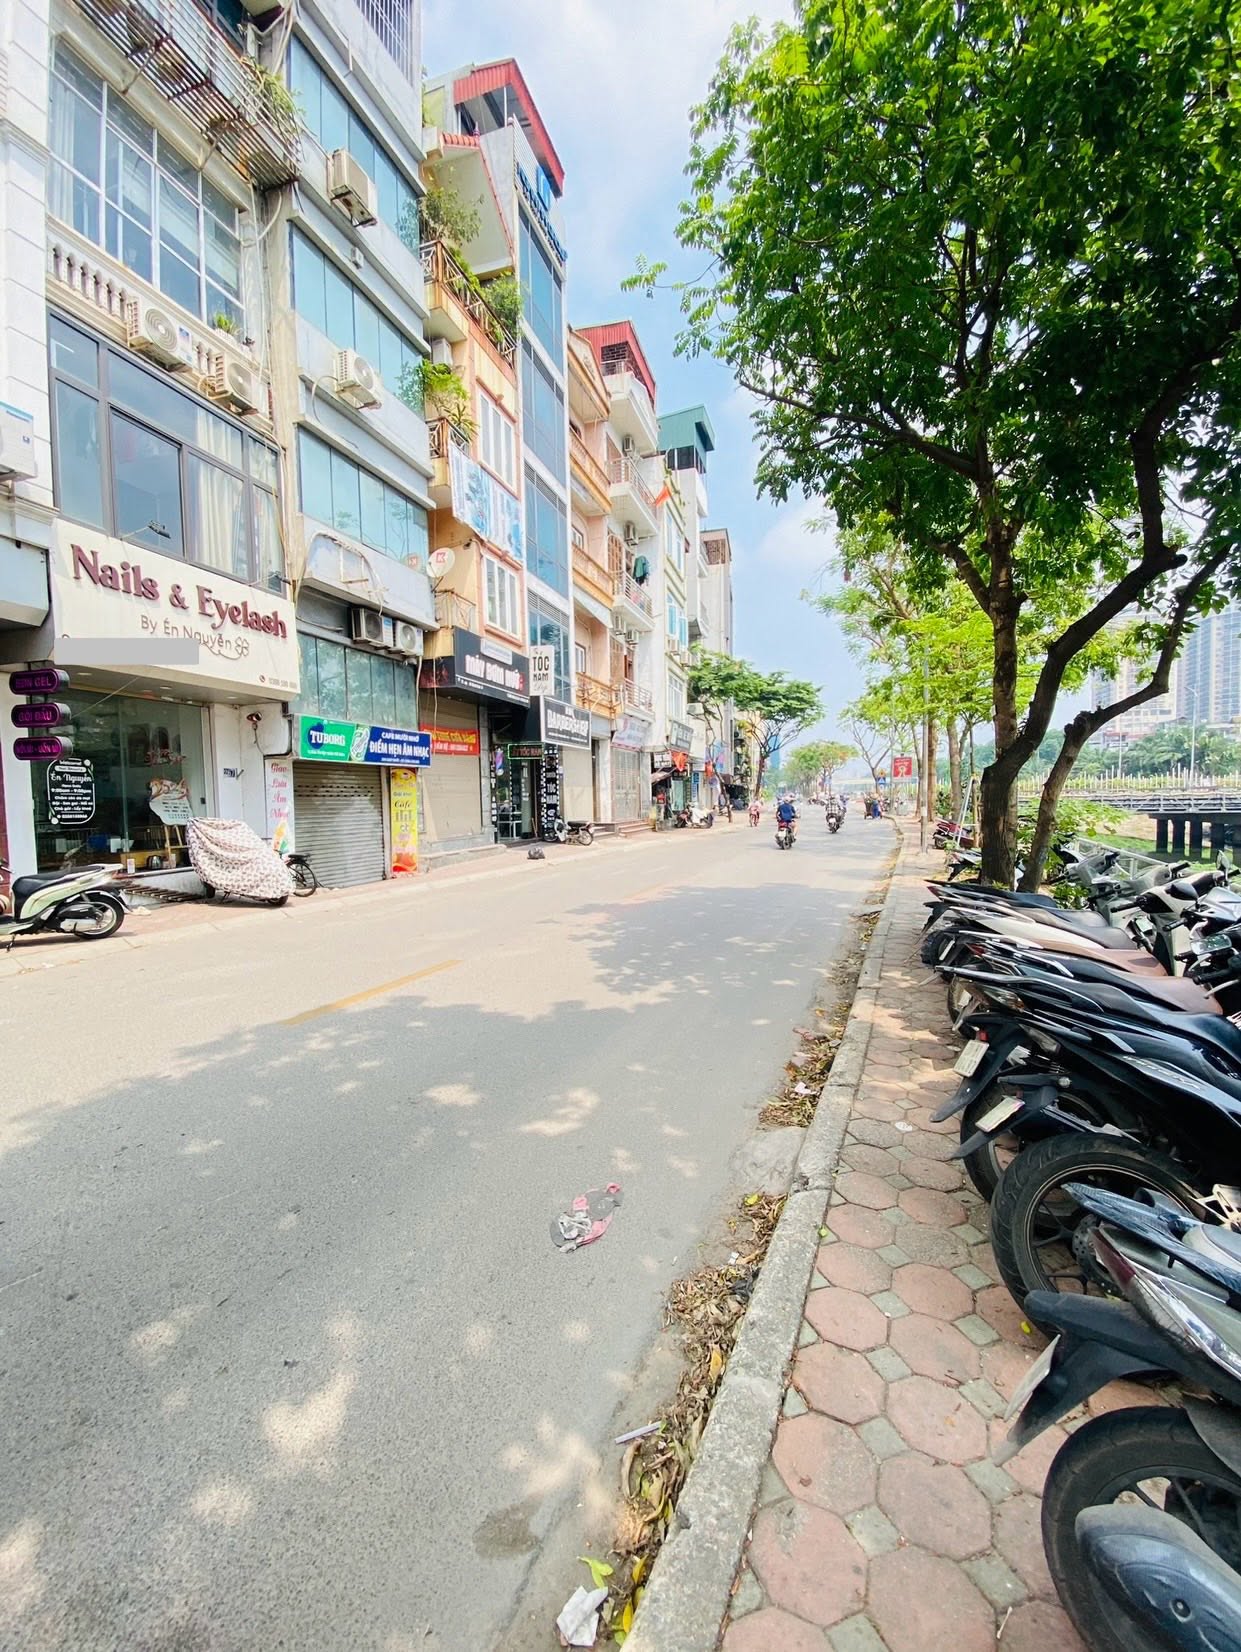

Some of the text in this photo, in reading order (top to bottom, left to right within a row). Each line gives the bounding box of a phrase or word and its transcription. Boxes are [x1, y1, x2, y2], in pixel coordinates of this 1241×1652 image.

[71, 543, 288, 638] Nails & Eyelash
[141, 615, 158, 634] By
[163, 617, 179, 636] Én
[310, 730, 346, 747] TUBORG
